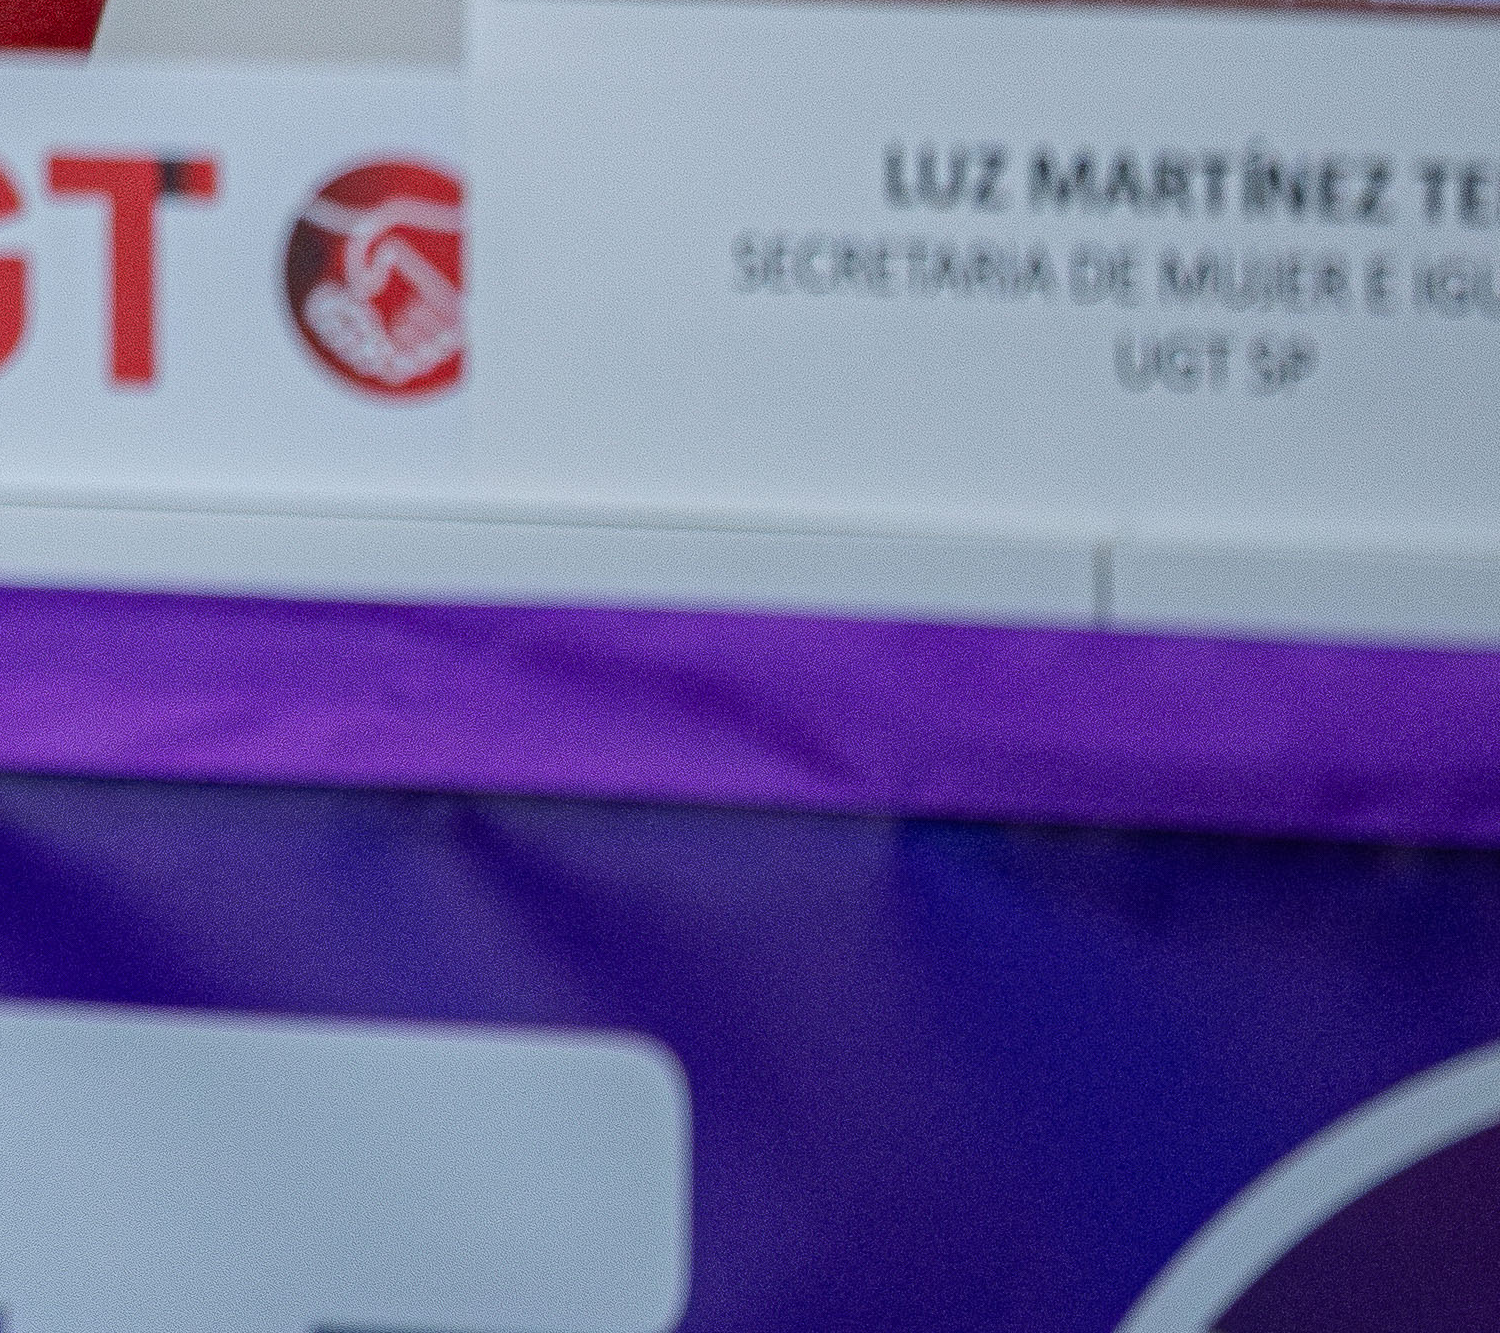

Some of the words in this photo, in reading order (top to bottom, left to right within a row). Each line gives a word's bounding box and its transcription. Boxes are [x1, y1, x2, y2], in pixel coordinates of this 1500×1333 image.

[882, 139, 1008, 213] LUZ
[1028, 134, 1396, 228] MARTÍNEZ
[1417, 151, 1500, 230] TE
[1069, 240, 1140, 308] DE
[1157, 243, 1352, 314] MUJER
[1361, 251, 1396, 320] E
[1114, 332, 1232, 394] UGT
